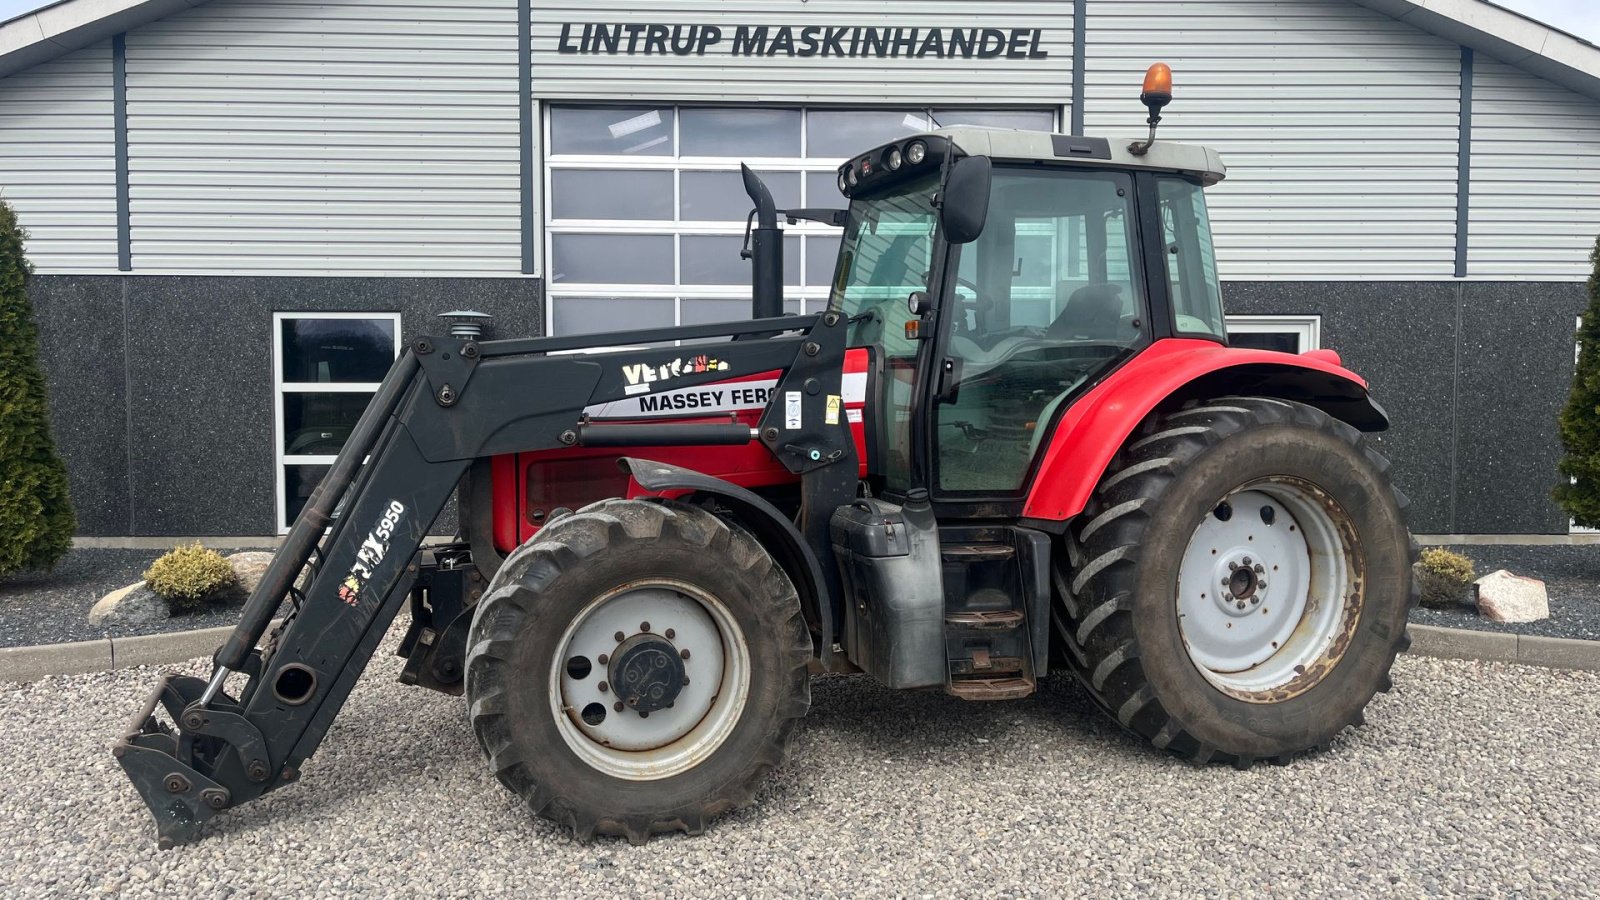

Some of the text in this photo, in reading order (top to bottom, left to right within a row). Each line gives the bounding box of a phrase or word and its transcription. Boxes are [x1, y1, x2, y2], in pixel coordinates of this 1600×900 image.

[558, 23, 1048, 59] LINTRUP MASKINHANDEL
[639, 391, 724, 412] MASSEY
[376, 500, 404, 541] 5950
